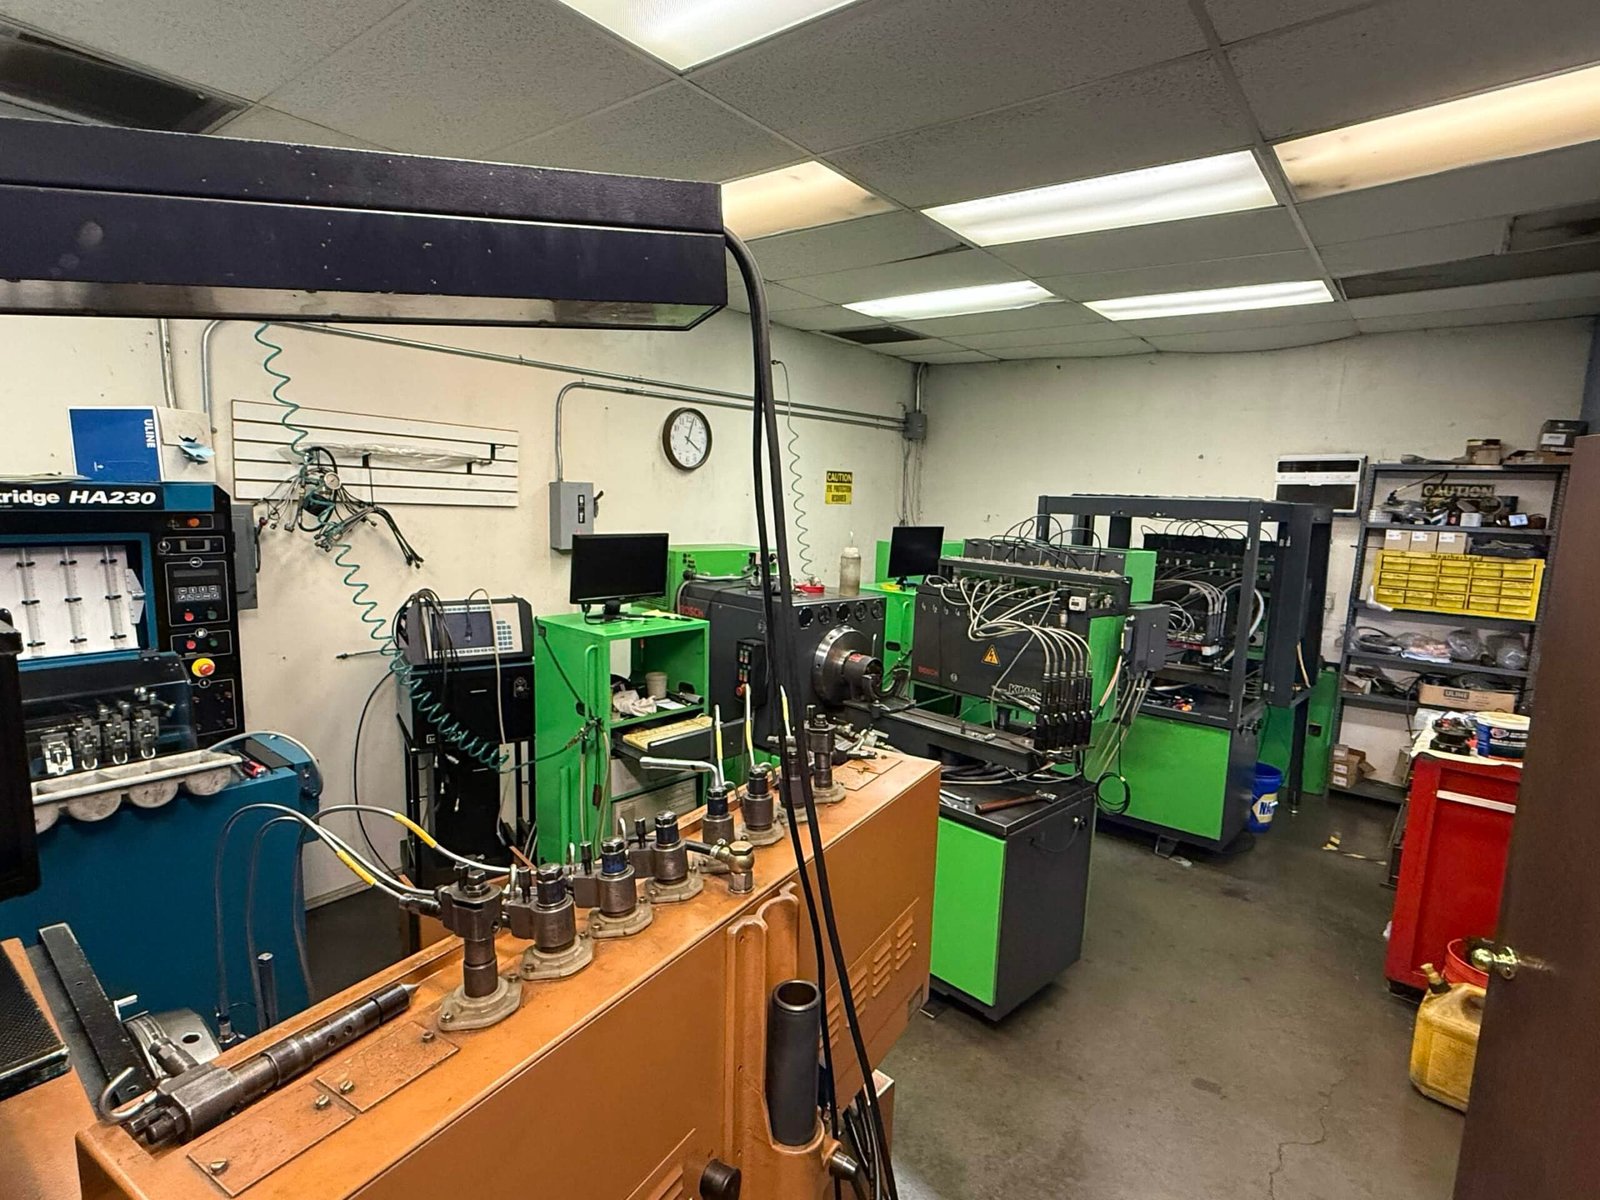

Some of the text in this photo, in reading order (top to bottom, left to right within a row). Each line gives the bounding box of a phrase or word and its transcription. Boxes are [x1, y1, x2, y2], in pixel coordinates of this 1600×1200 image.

[144, 418, 156, 448] ULINE
[827, 472, 851, 482] CAUTION
[1423, 485, 1494, 497] CAUTION
[69, 490, 156, 505] HA230
[1445, 690, 1467, 699] ULINE
